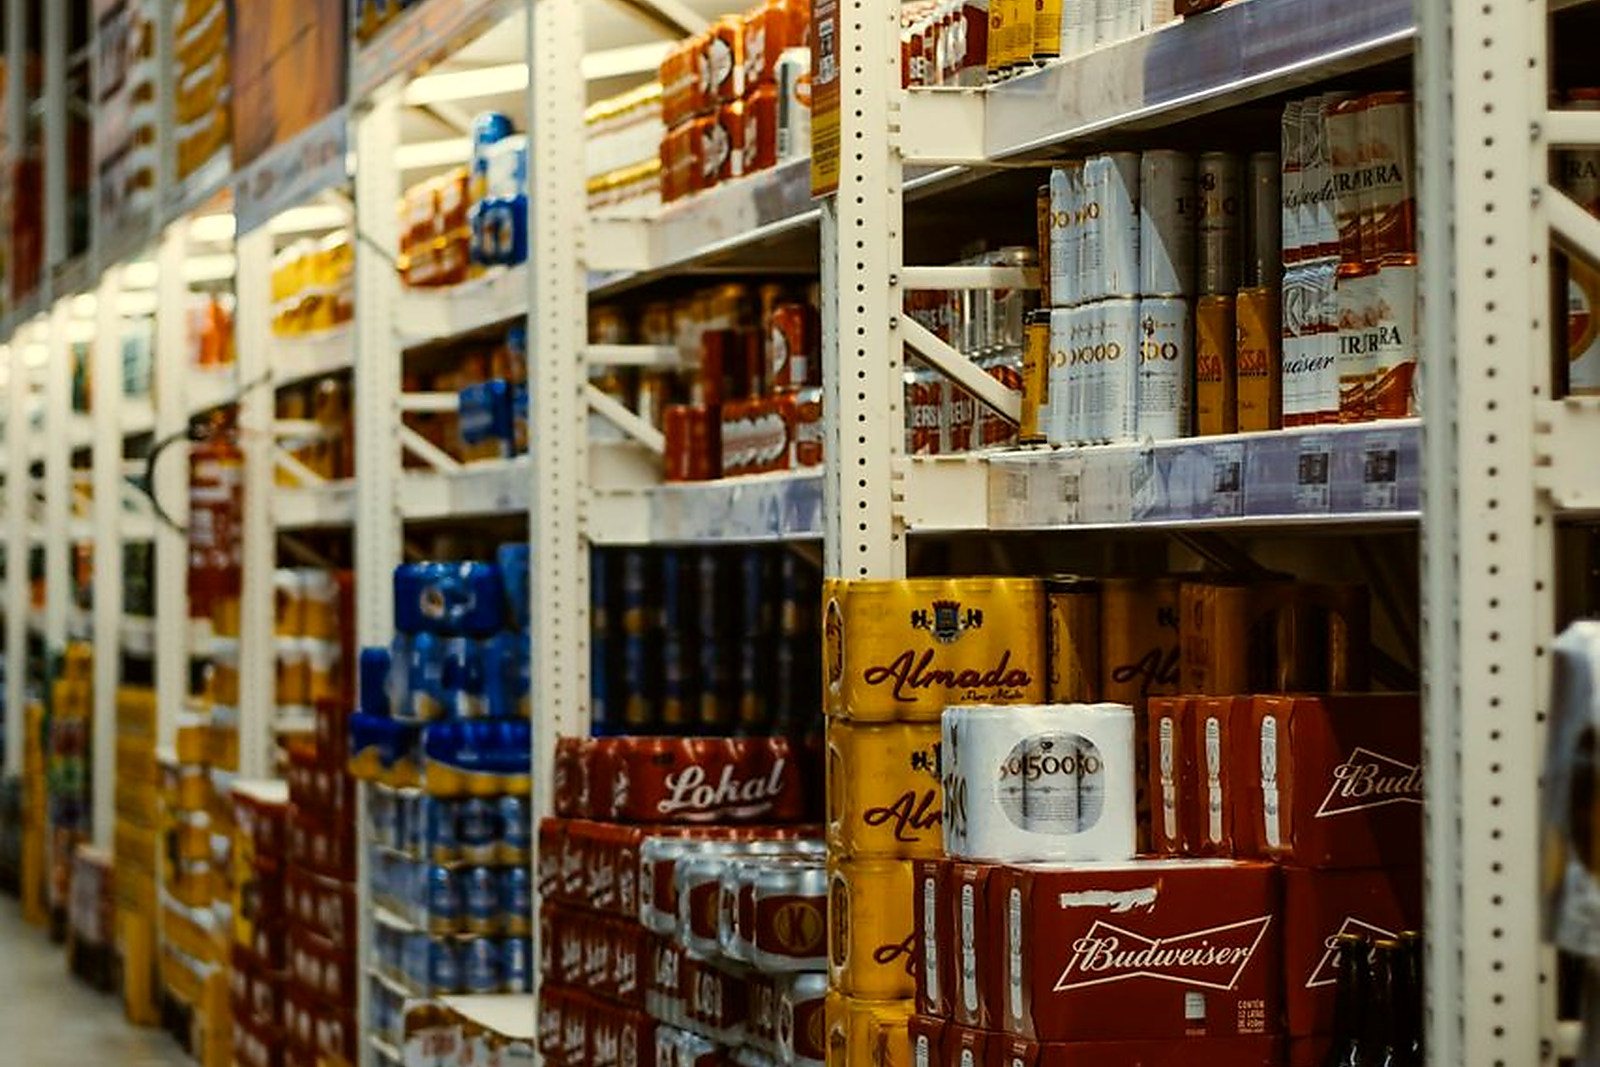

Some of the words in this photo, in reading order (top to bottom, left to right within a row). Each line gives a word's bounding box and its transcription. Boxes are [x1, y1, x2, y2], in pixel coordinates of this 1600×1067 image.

[863, 648, 1032, 703] Almada
[657, 758, 786, 811] Lokal
[1072, 937, 1250, 971] Budweiser
